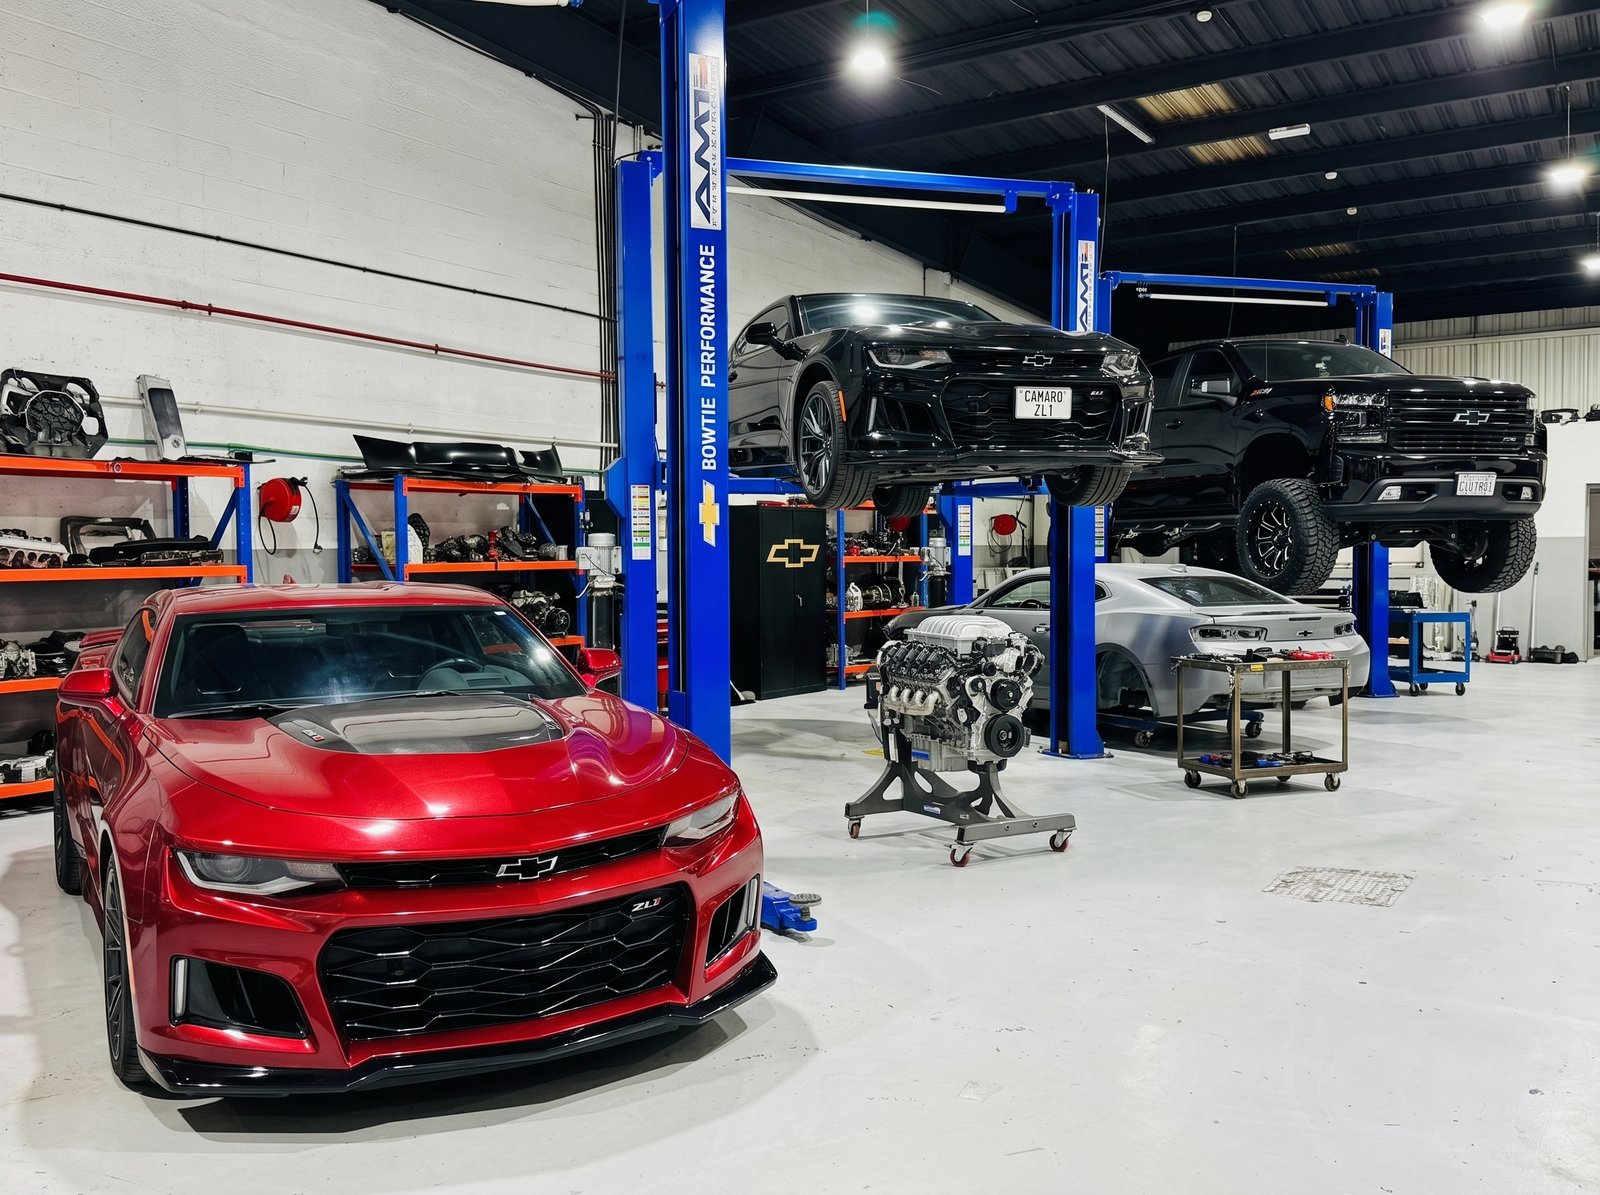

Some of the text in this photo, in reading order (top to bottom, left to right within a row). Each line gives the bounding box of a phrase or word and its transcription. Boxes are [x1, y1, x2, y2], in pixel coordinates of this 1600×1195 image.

[699, 244, 716, 388] PERFORMANCE
[1024, 390, 1063, 403] CAMARO
[1034, 404, 1053, 417] ZL1
[702, 398, 717, 470] BOWTIE
[631, 897, 662, 912] ZL1
